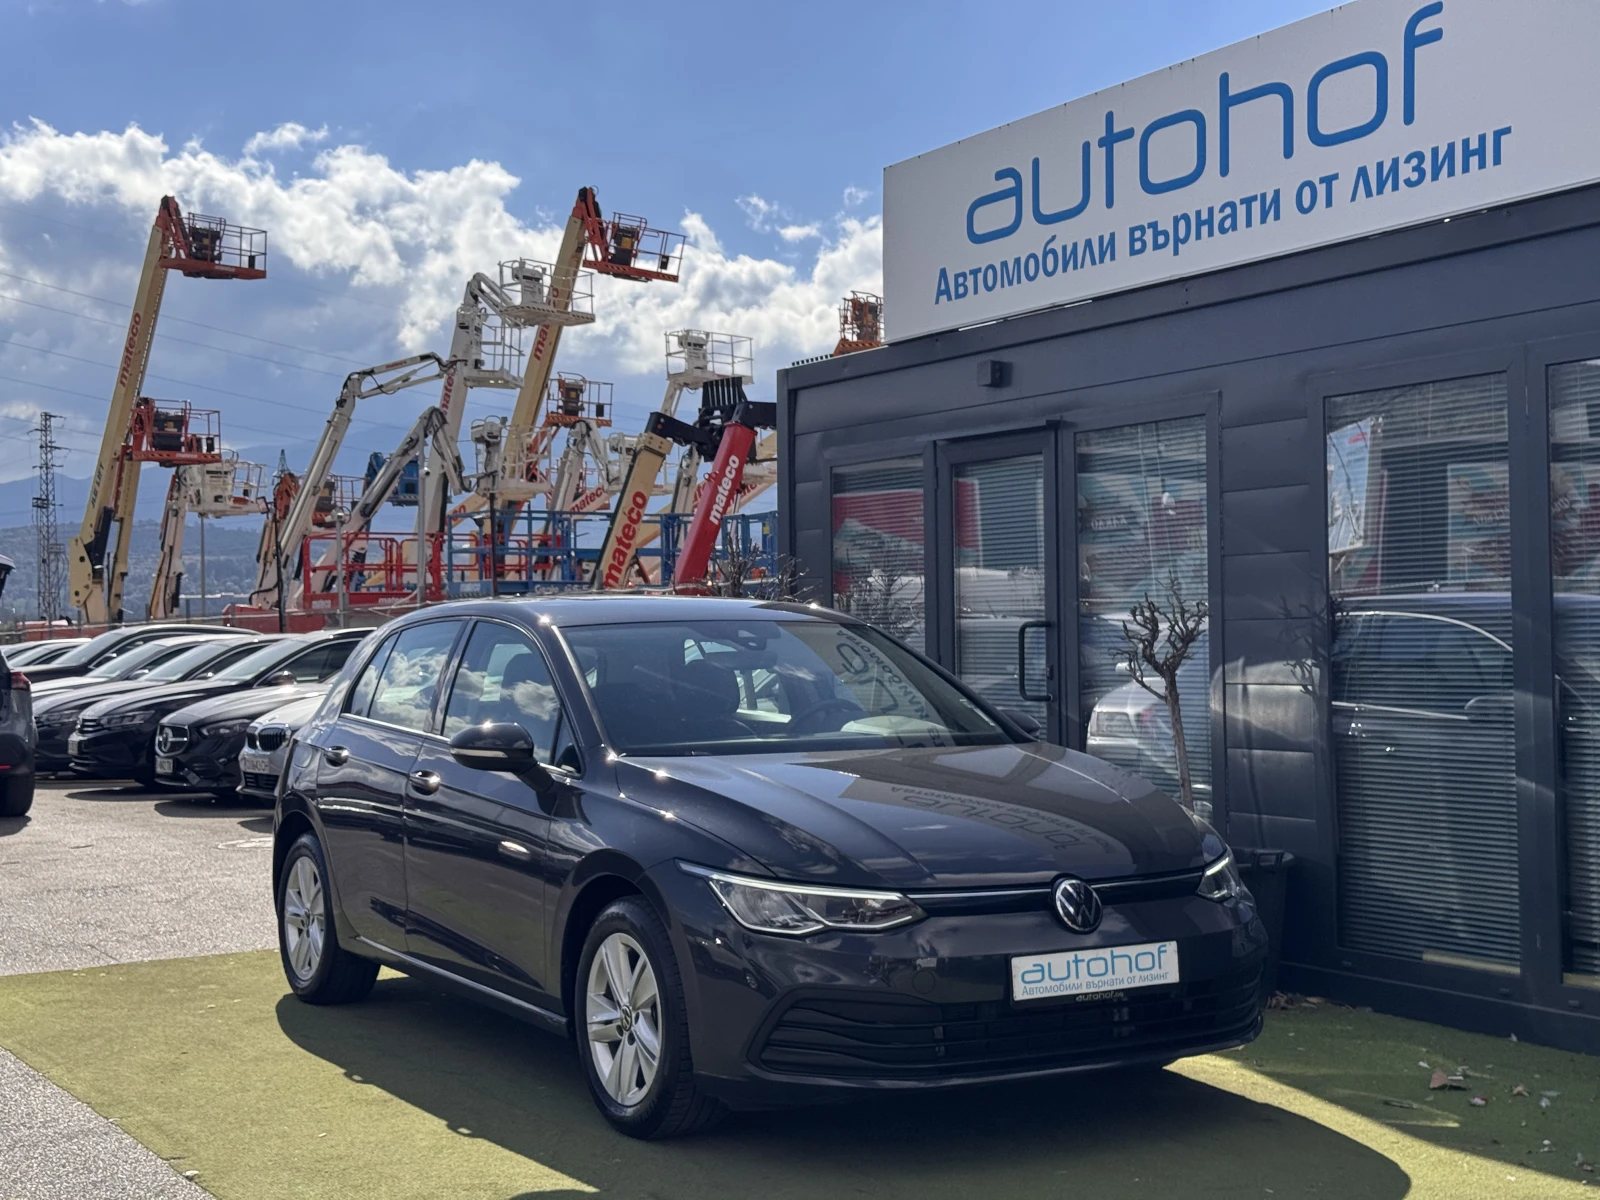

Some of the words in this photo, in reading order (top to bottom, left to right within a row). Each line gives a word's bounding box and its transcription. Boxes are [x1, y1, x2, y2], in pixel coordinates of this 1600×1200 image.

[966, 1, 1444, 244] autohof
[934, 233, 1117, 304] Автомобили
[1128, 186, 1282, 258] върнати
[1295, 171, 1340, 215] от
[1350, 126, 1513, 202] лизинг
[119, 312, 142, 389] mateco
[709, 454, 740, 526] mateco
[603, 490, 647, 588] mateco
[1020, 943, 1168, 985] autohof
[1021, 981, 1083, 997] Автомобили
[1085, 977, 1125, 991] върнати
[1126, 975, 1137, 984] от
[1138, 971, 1170, 983] лизинг
